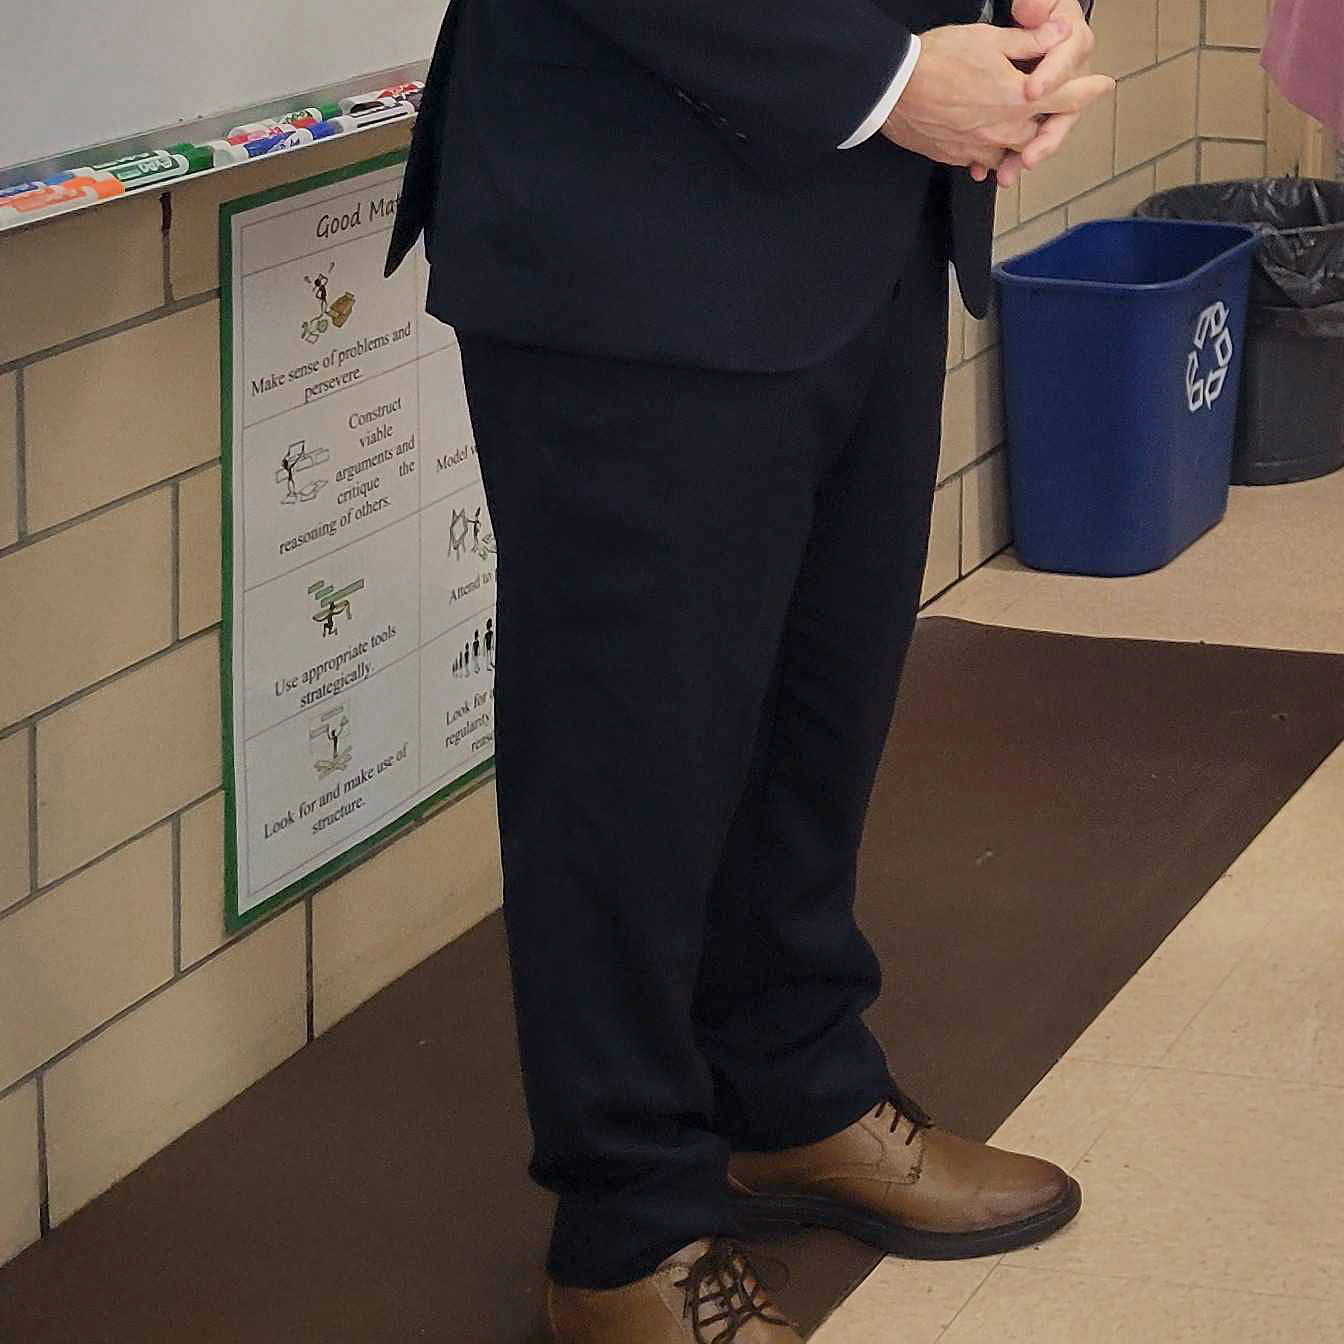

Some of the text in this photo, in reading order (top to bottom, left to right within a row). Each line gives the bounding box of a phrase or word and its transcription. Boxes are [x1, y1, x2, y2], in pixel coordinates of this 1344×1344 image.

[316, 196, 402, 238] Good Mat
[251, 322, 412, 397] Make sense of problems and
[304, 366, 364, 404] persevere.
[348, 397, 402, 430] Construct
[359, 423, 393, 448] viable
[335, 434, 416, 483] arguments and
[435, 444, 469, 473] Model
[337, 458, 416, 506] critique the
[279, 520, 337, 556] reasoning
[340, 508, 353, 530] of
[448, 568, 494, 606] Attend to
[274, 624, 397, 698] Use appropriate tools
[299, 659, 376, 708] strategically.
[445, 689, 489, 726] Look for
[263, 742, 410, 840] Look for and make use of
[311, 795, 367, 835] structure.
